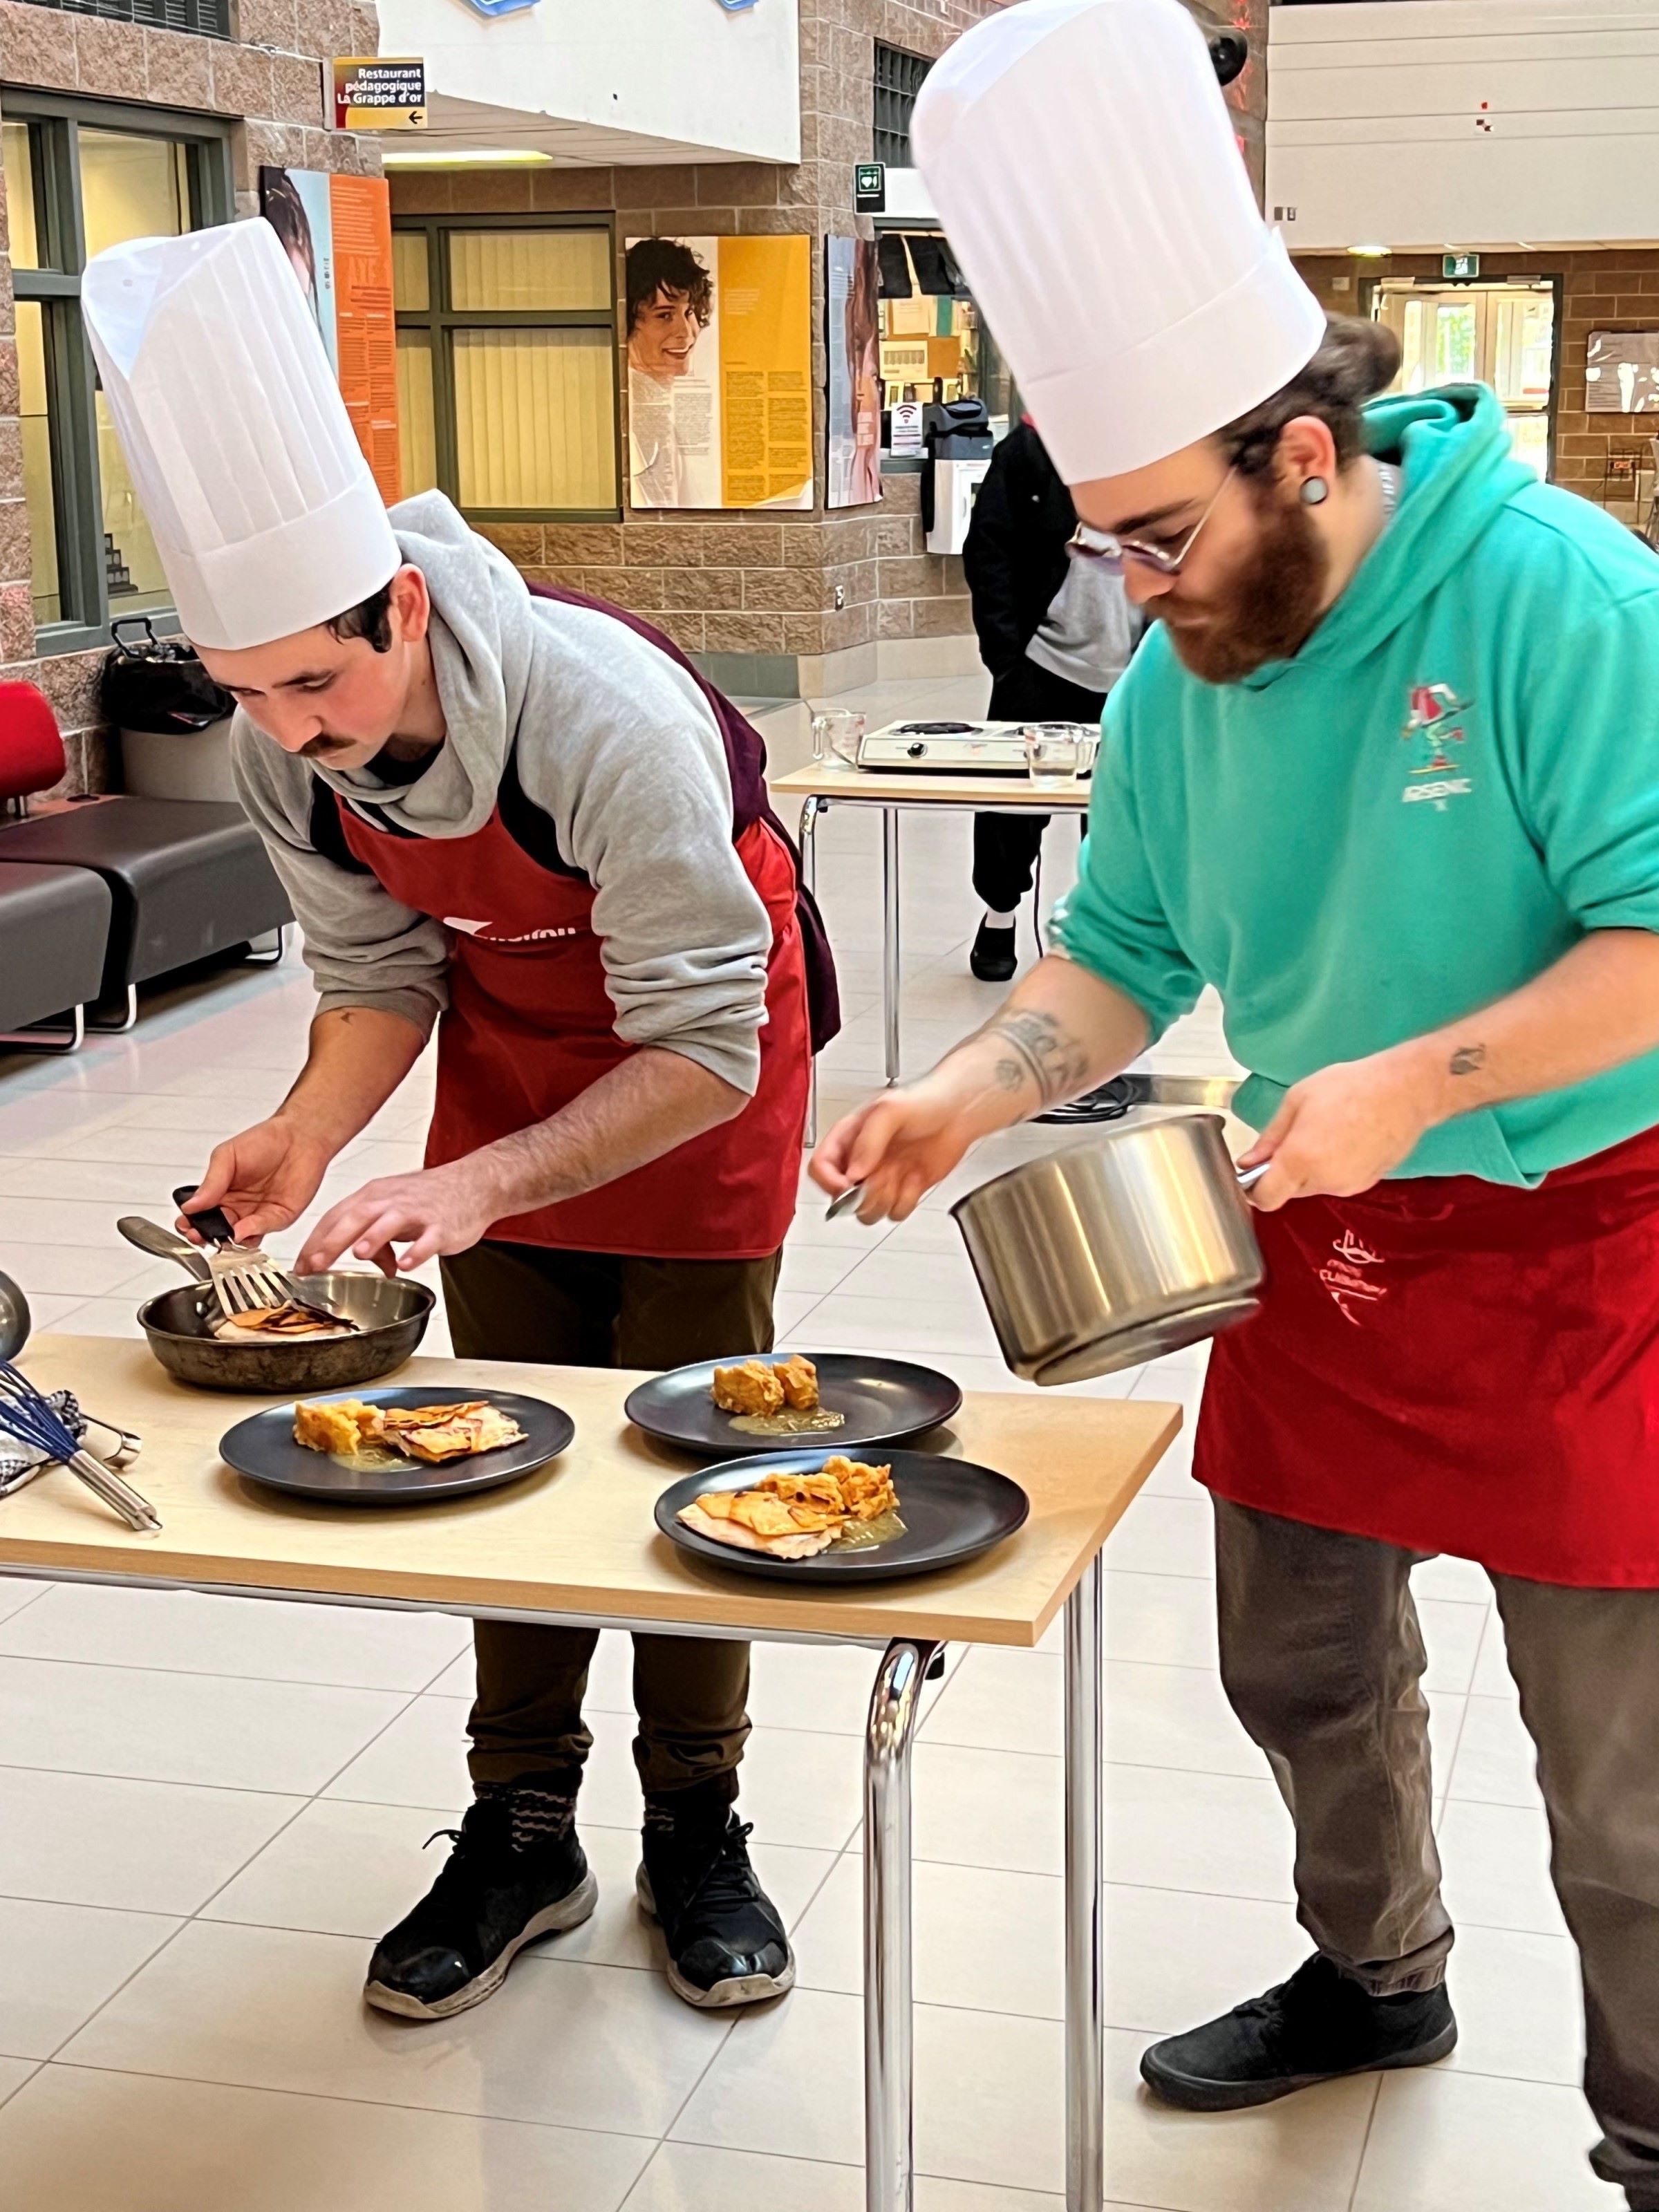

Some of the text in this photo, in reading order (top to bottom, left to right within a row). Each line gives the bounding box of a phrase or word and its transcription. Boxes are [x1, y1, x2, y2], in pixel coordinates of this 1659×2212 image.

[359, 68, 421, 78] Restaurant
[345, 80, 421, 93] pédagogique
[337, 92, 422, 105] La Grappe d'or
